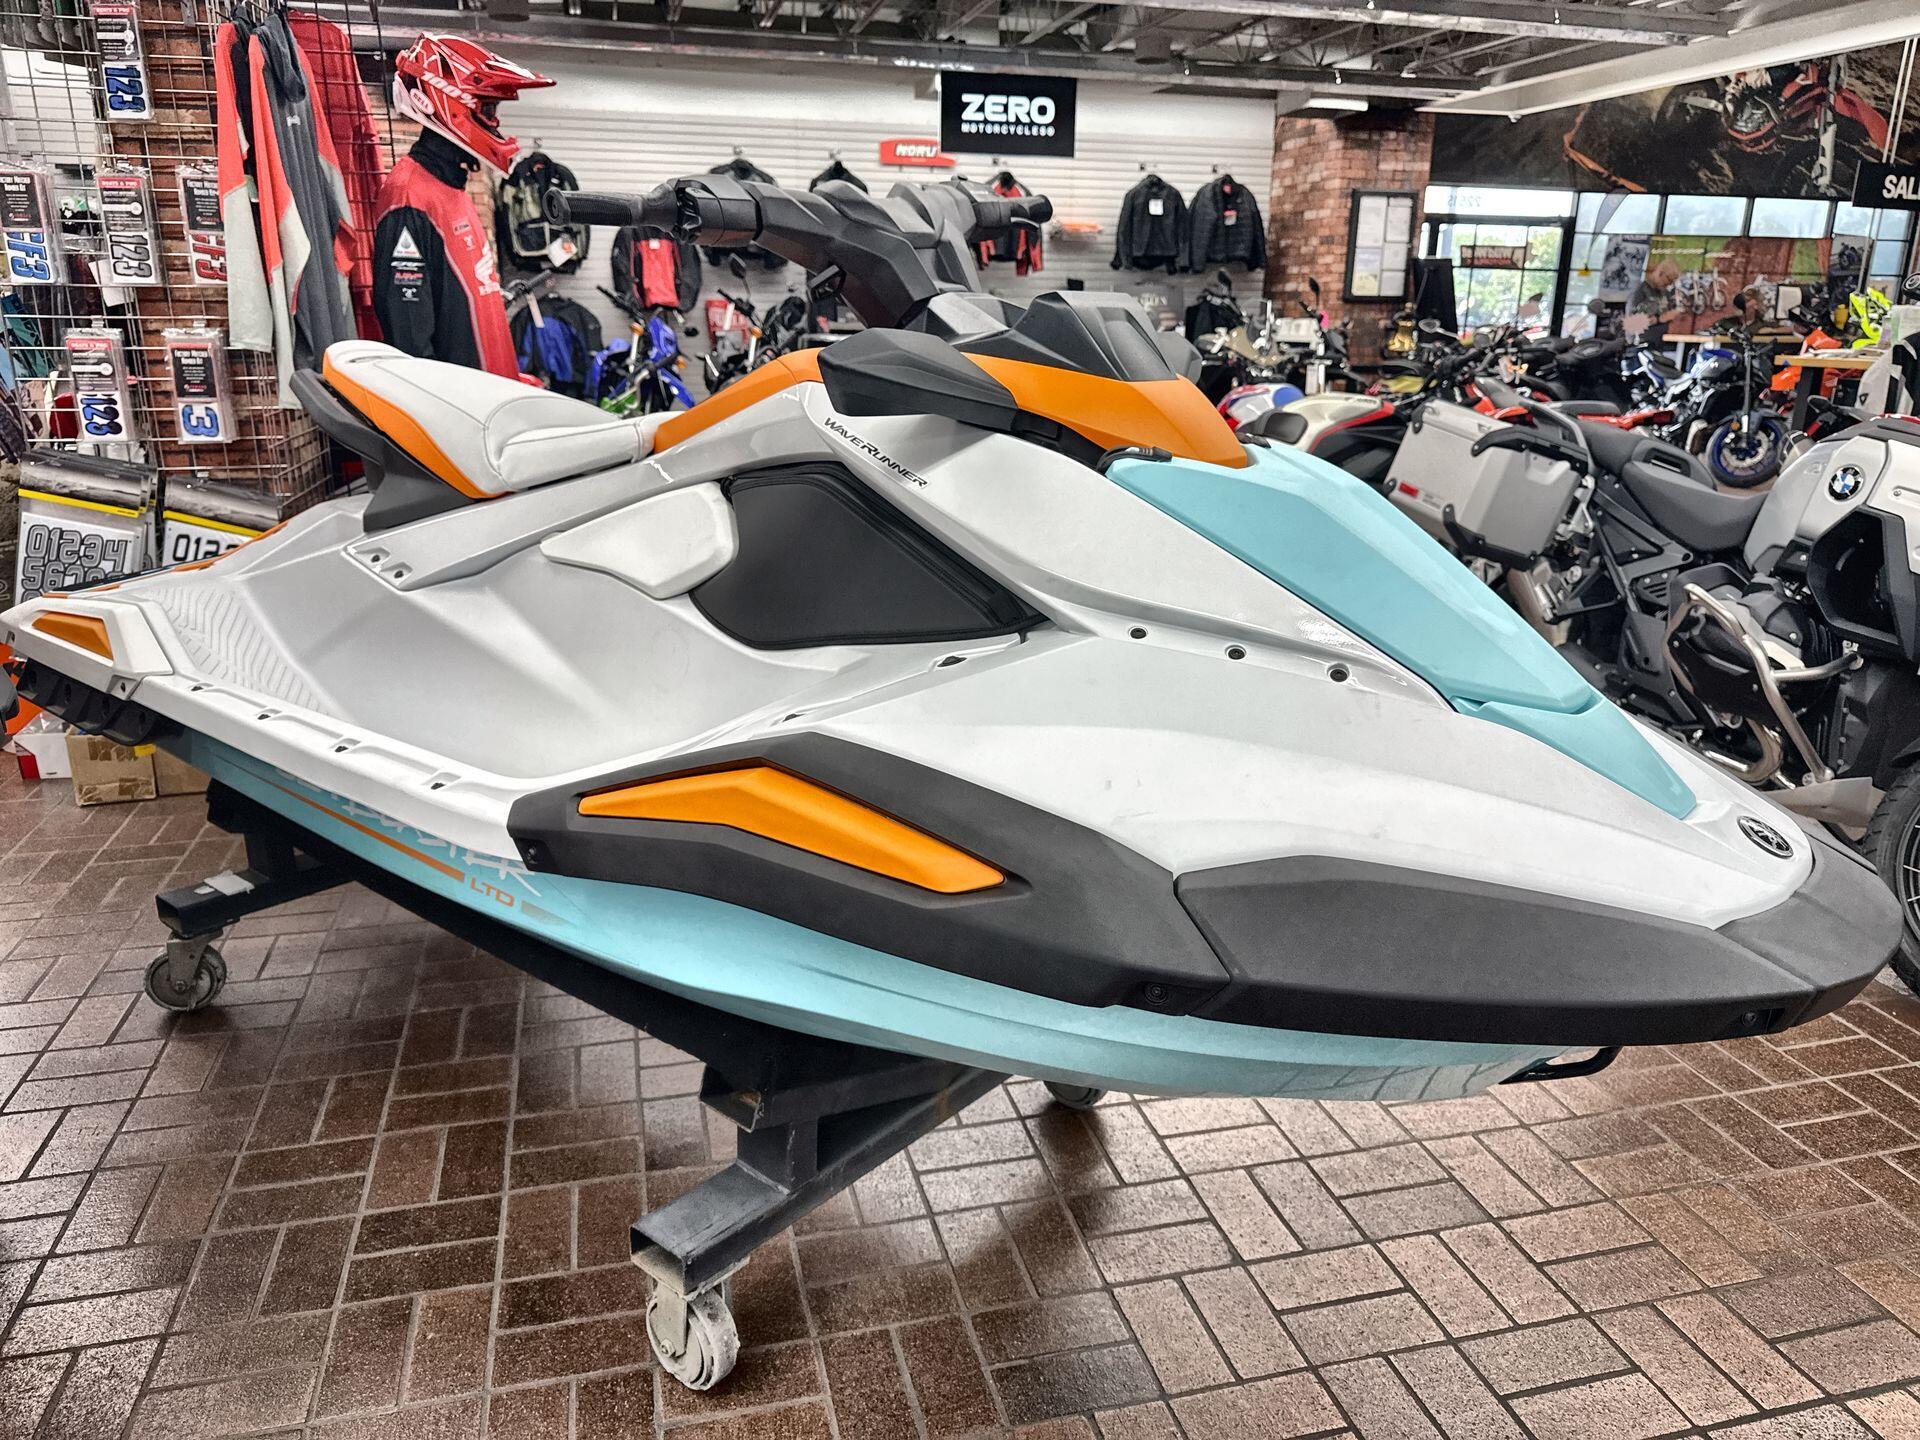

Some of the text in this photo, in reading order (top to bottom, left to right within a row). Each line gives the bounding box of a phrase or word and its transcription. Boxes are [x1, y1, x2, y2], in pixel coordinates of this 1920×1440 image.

[104, 66, 146, 112] 123
[961, 93, 1056, 125] ZERO
[1882, 174, 1920, 201] SAL
[109, 234, 153, 278] 123
[80, 394, 123, 435] 123
[181, 404, 220, 438] 3
[824, 417, 928, 489] WAVERUNNER
[26, 524, 128, 572] 01234
[172, 534, 240, 562] 012
[21, 557, 124, 592] 567
[470, 877, 515, 908] LTD
